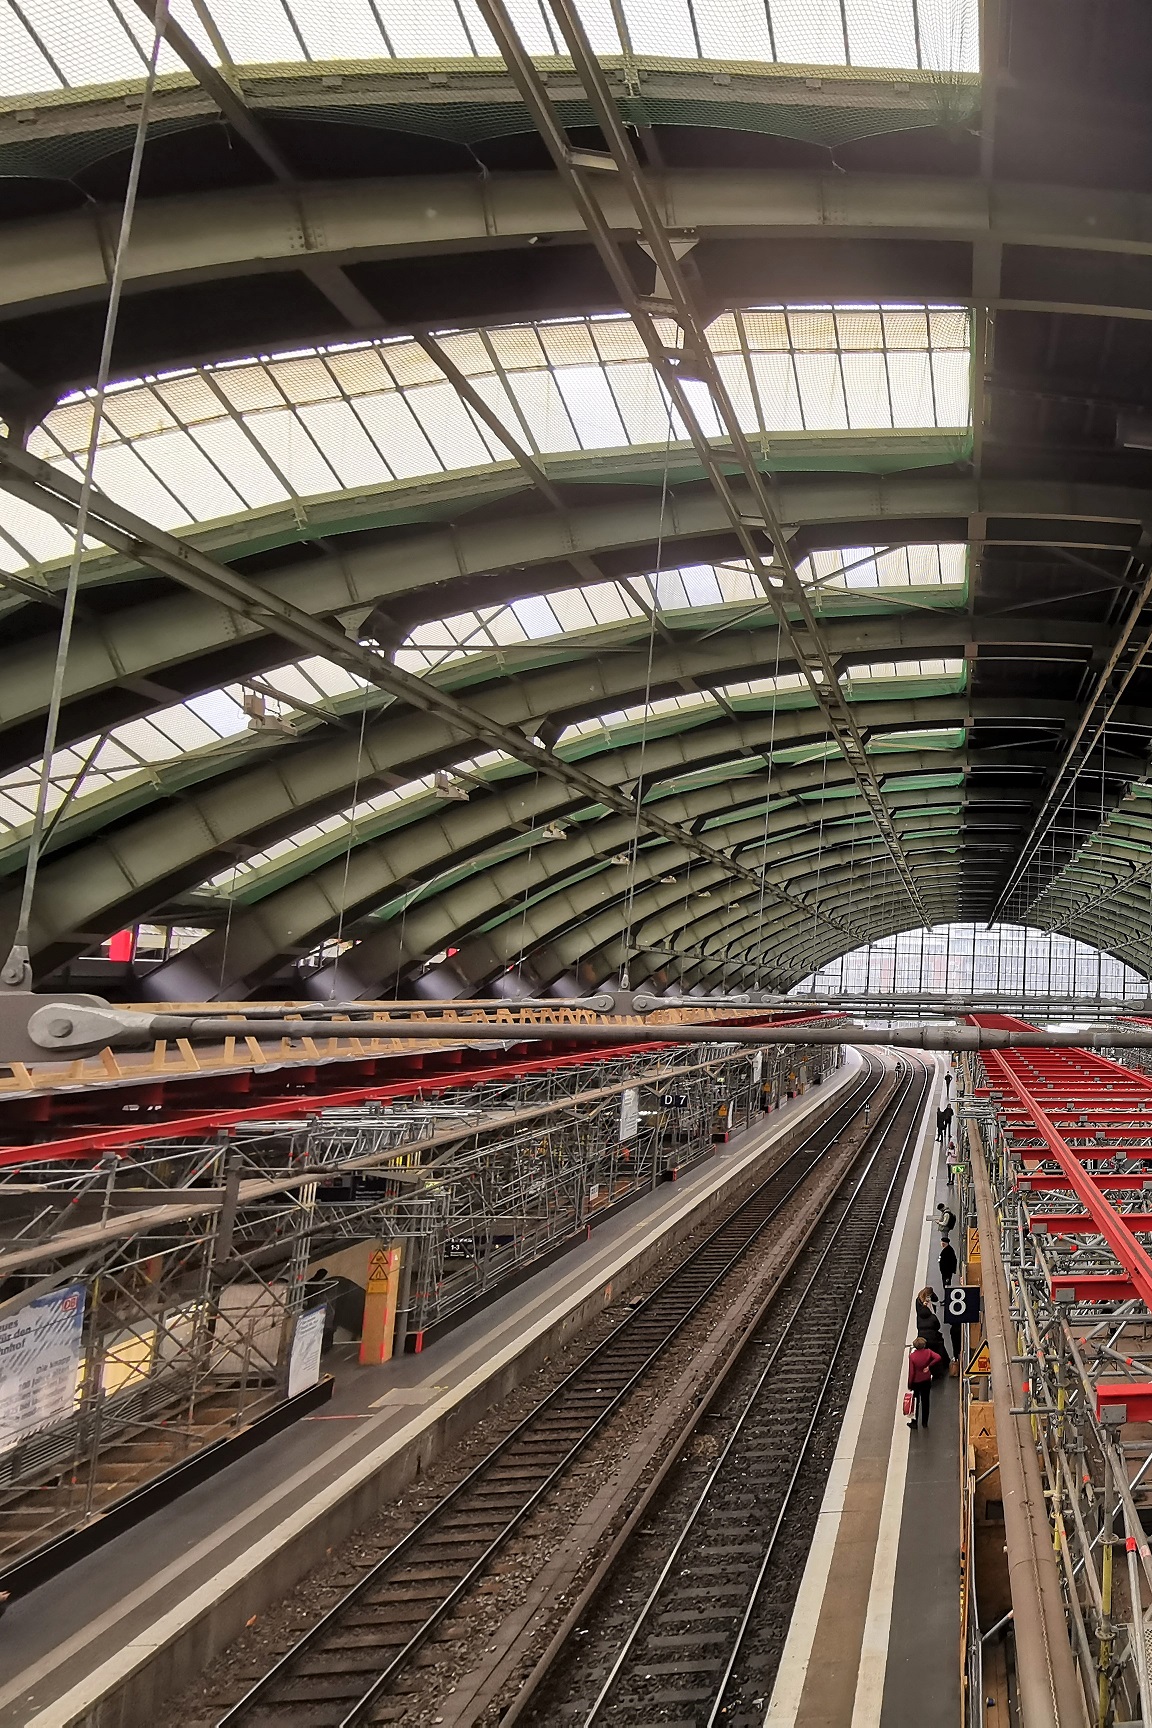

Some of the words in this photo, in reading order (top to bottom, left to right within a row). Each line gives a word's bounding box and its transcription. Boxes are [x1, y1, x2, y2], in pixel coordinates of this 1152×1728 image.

[664, 1095, 673, 1105] D
[679, 1095, 687, 1105] 7
[63, 1297, 77, 1310] DB
[948, 1288, 967, 1316] 8
[13, 1327, 32, 1339] den
